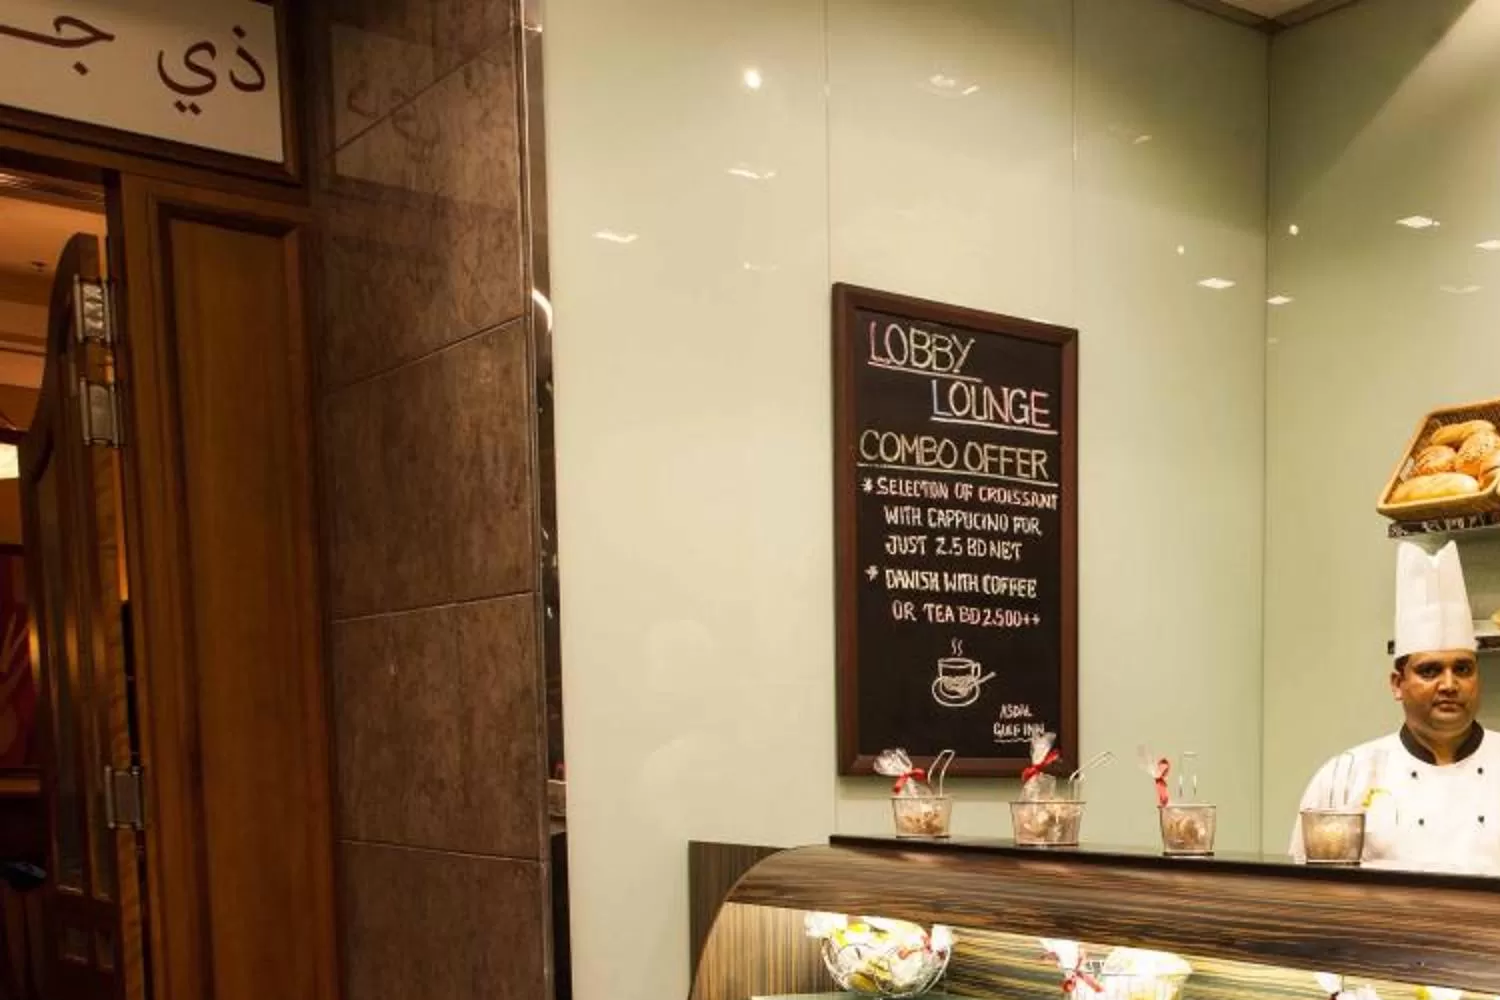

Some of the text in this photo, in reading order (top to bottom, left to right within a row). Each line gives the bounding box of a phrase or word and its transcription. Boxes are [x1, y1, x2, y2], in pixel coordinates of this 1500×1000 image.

[869, 321, 976, 374] LOBBY
[930, 378, 1051, 429] LOUNGE
[859, 429, 1050, 480] COMBO OFFER
[954, 482, 974, 501] OF
[978, 485, 1058, 511] CROISSANT
[883, 505, 1043, 538] WITH CAPPUCINO FOR
[884, 535, 928, 556] JUST
[935, 537, 963, 556] 2.5
[989, 540, 1022, 561] NET
[885, 568, 1037, 599] DANISH WITH COFFEE
[892, 599, 918, 622] OR
[922, 603, 955, 624] TEA
